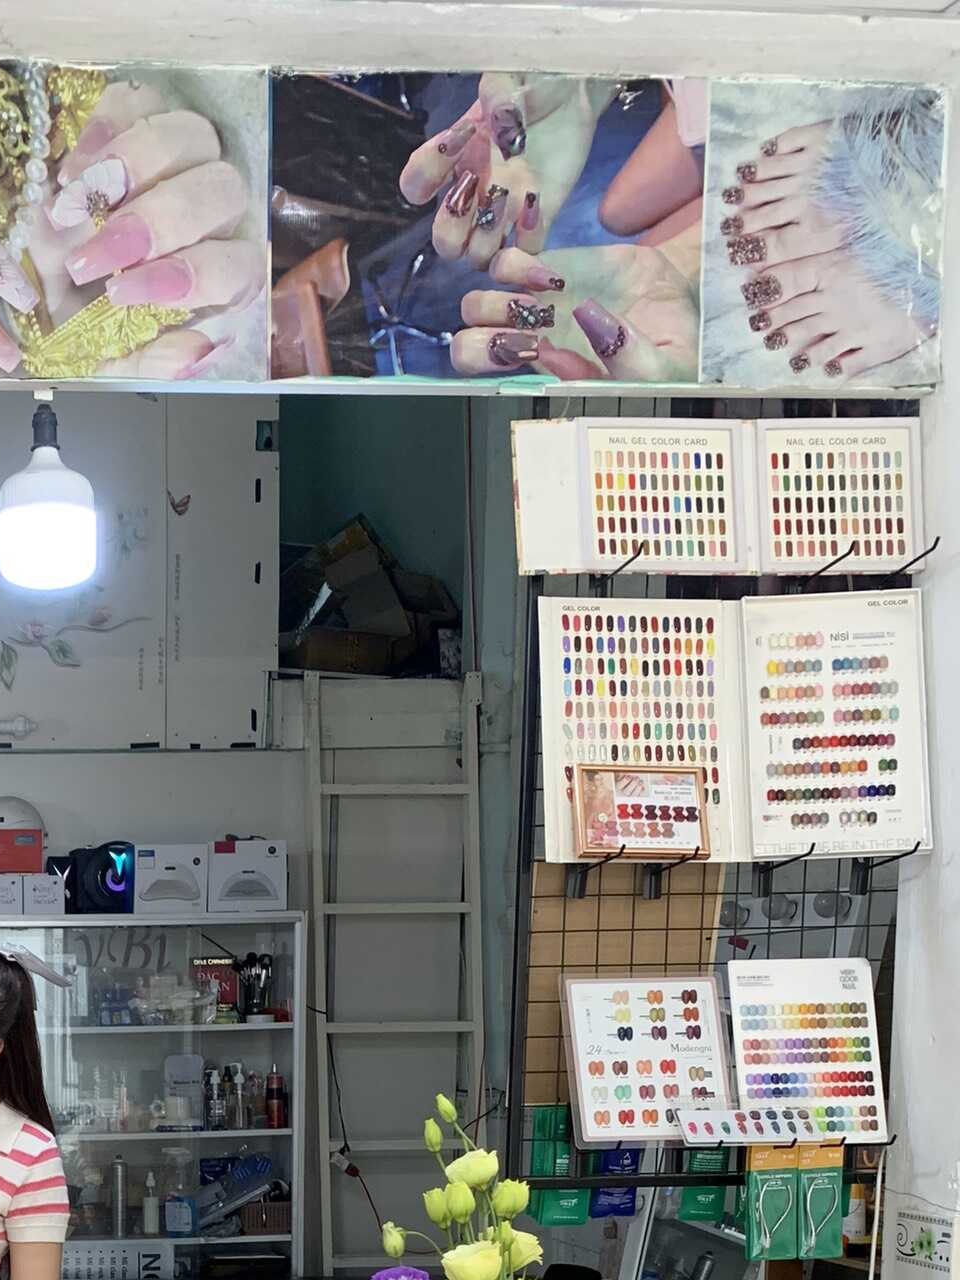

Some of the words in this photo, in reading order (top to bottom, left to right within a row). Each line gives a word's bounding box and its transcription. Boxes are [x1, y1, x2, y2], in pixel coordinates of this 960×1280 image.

[608, 437, 628, 446] NAIL
[631, 437, 647, 446] GEL
[651, 438, 681, 446] COLOR
[684, 438, 708, 446] CARD
[786, 438, 806, 446] NAIL
[808, 438, 825, 446] GEL
[829, 437, 858, 446] COLOR
[862, 436, 887, 446] CARD
